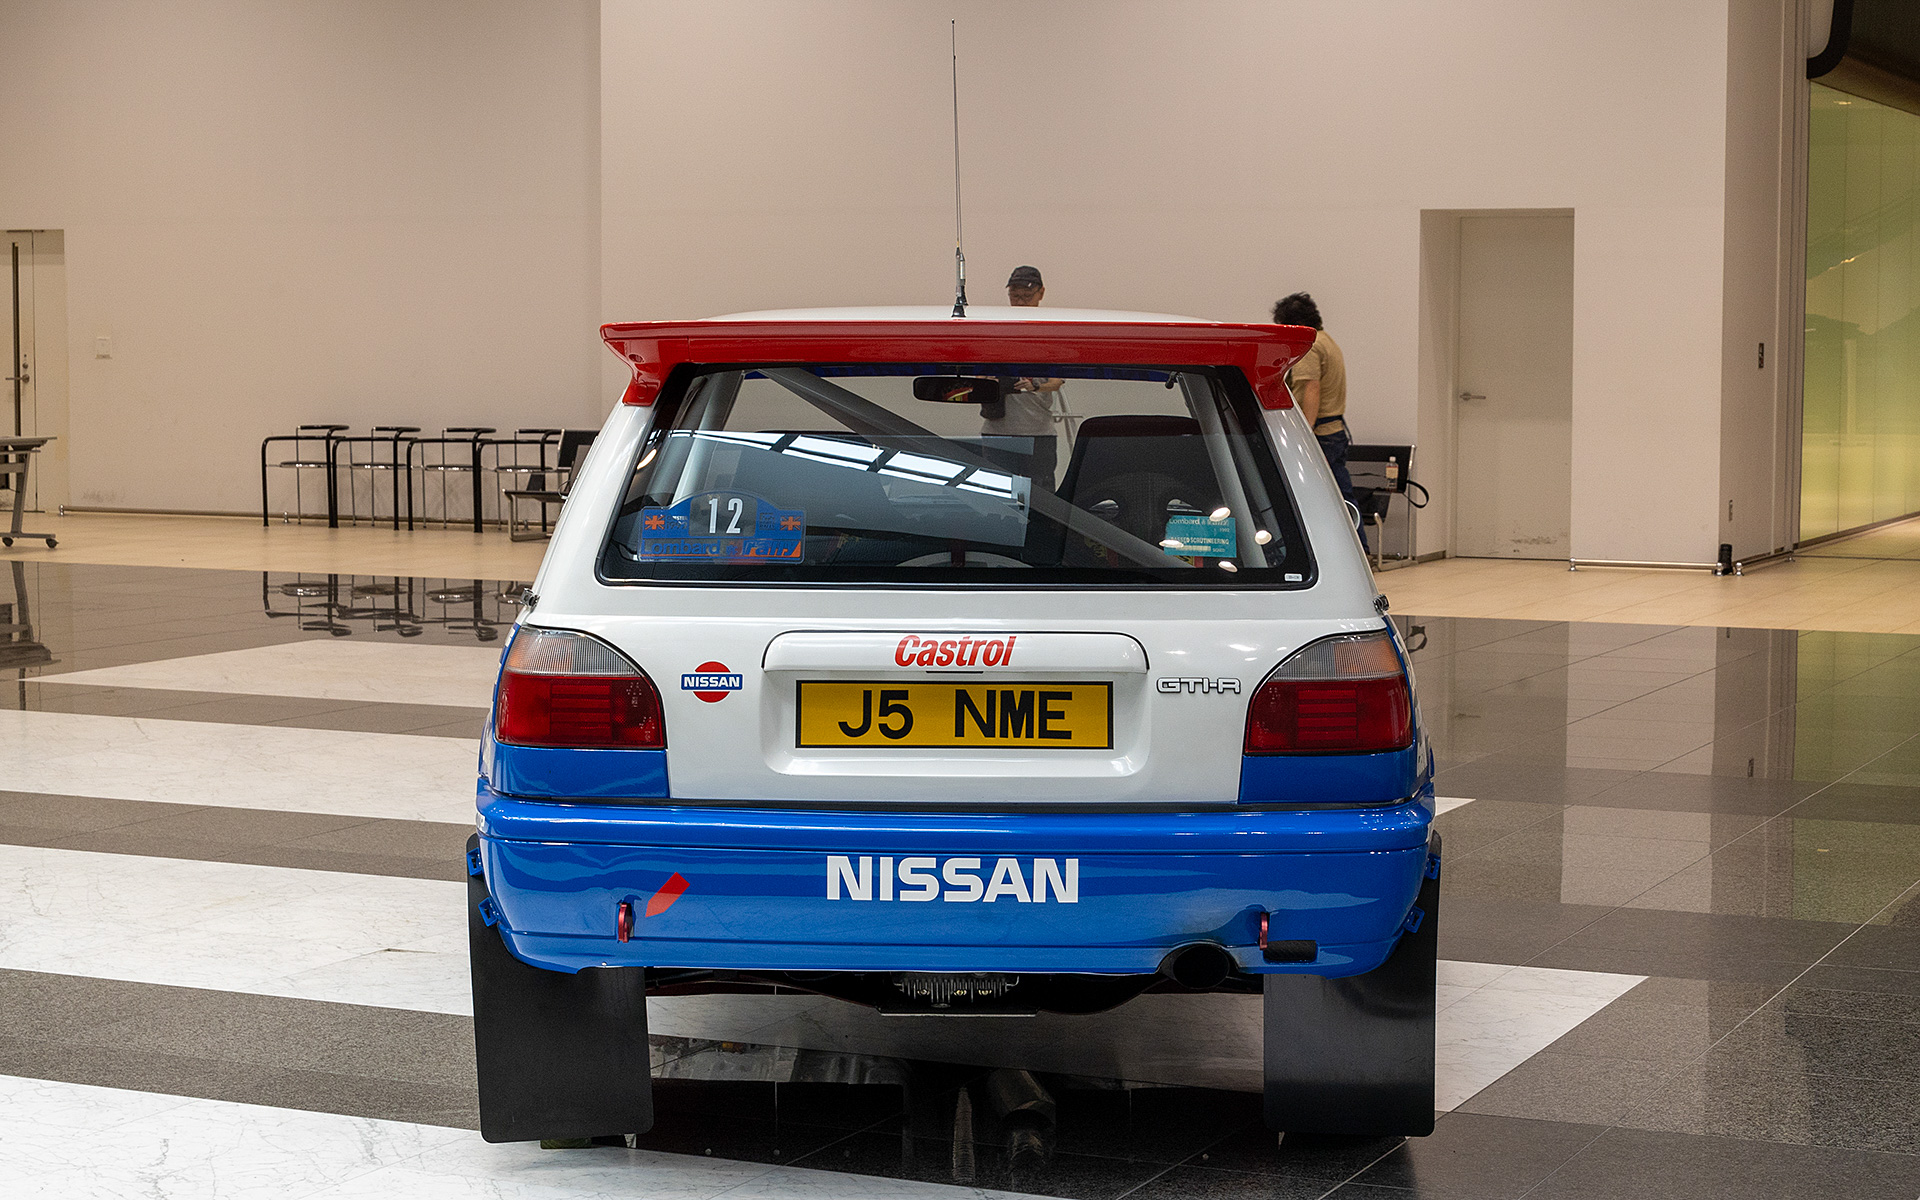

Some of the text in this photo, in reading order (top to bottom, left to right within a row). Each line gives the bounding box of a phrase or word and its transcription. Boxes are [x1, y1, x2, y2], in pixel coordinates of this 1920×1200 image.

[708, 497, 744, 535] 12
[642, 539, 721, 555] Lombard
[894, 634, 1018, 668] Castrol
[682, 674, 742, 689] NISSAN
[1156, 676, 1242, 695] GTI-R
[837, 689, 1074, 740] J5 NME
[826, 855, 1079, 903] NISSAN
